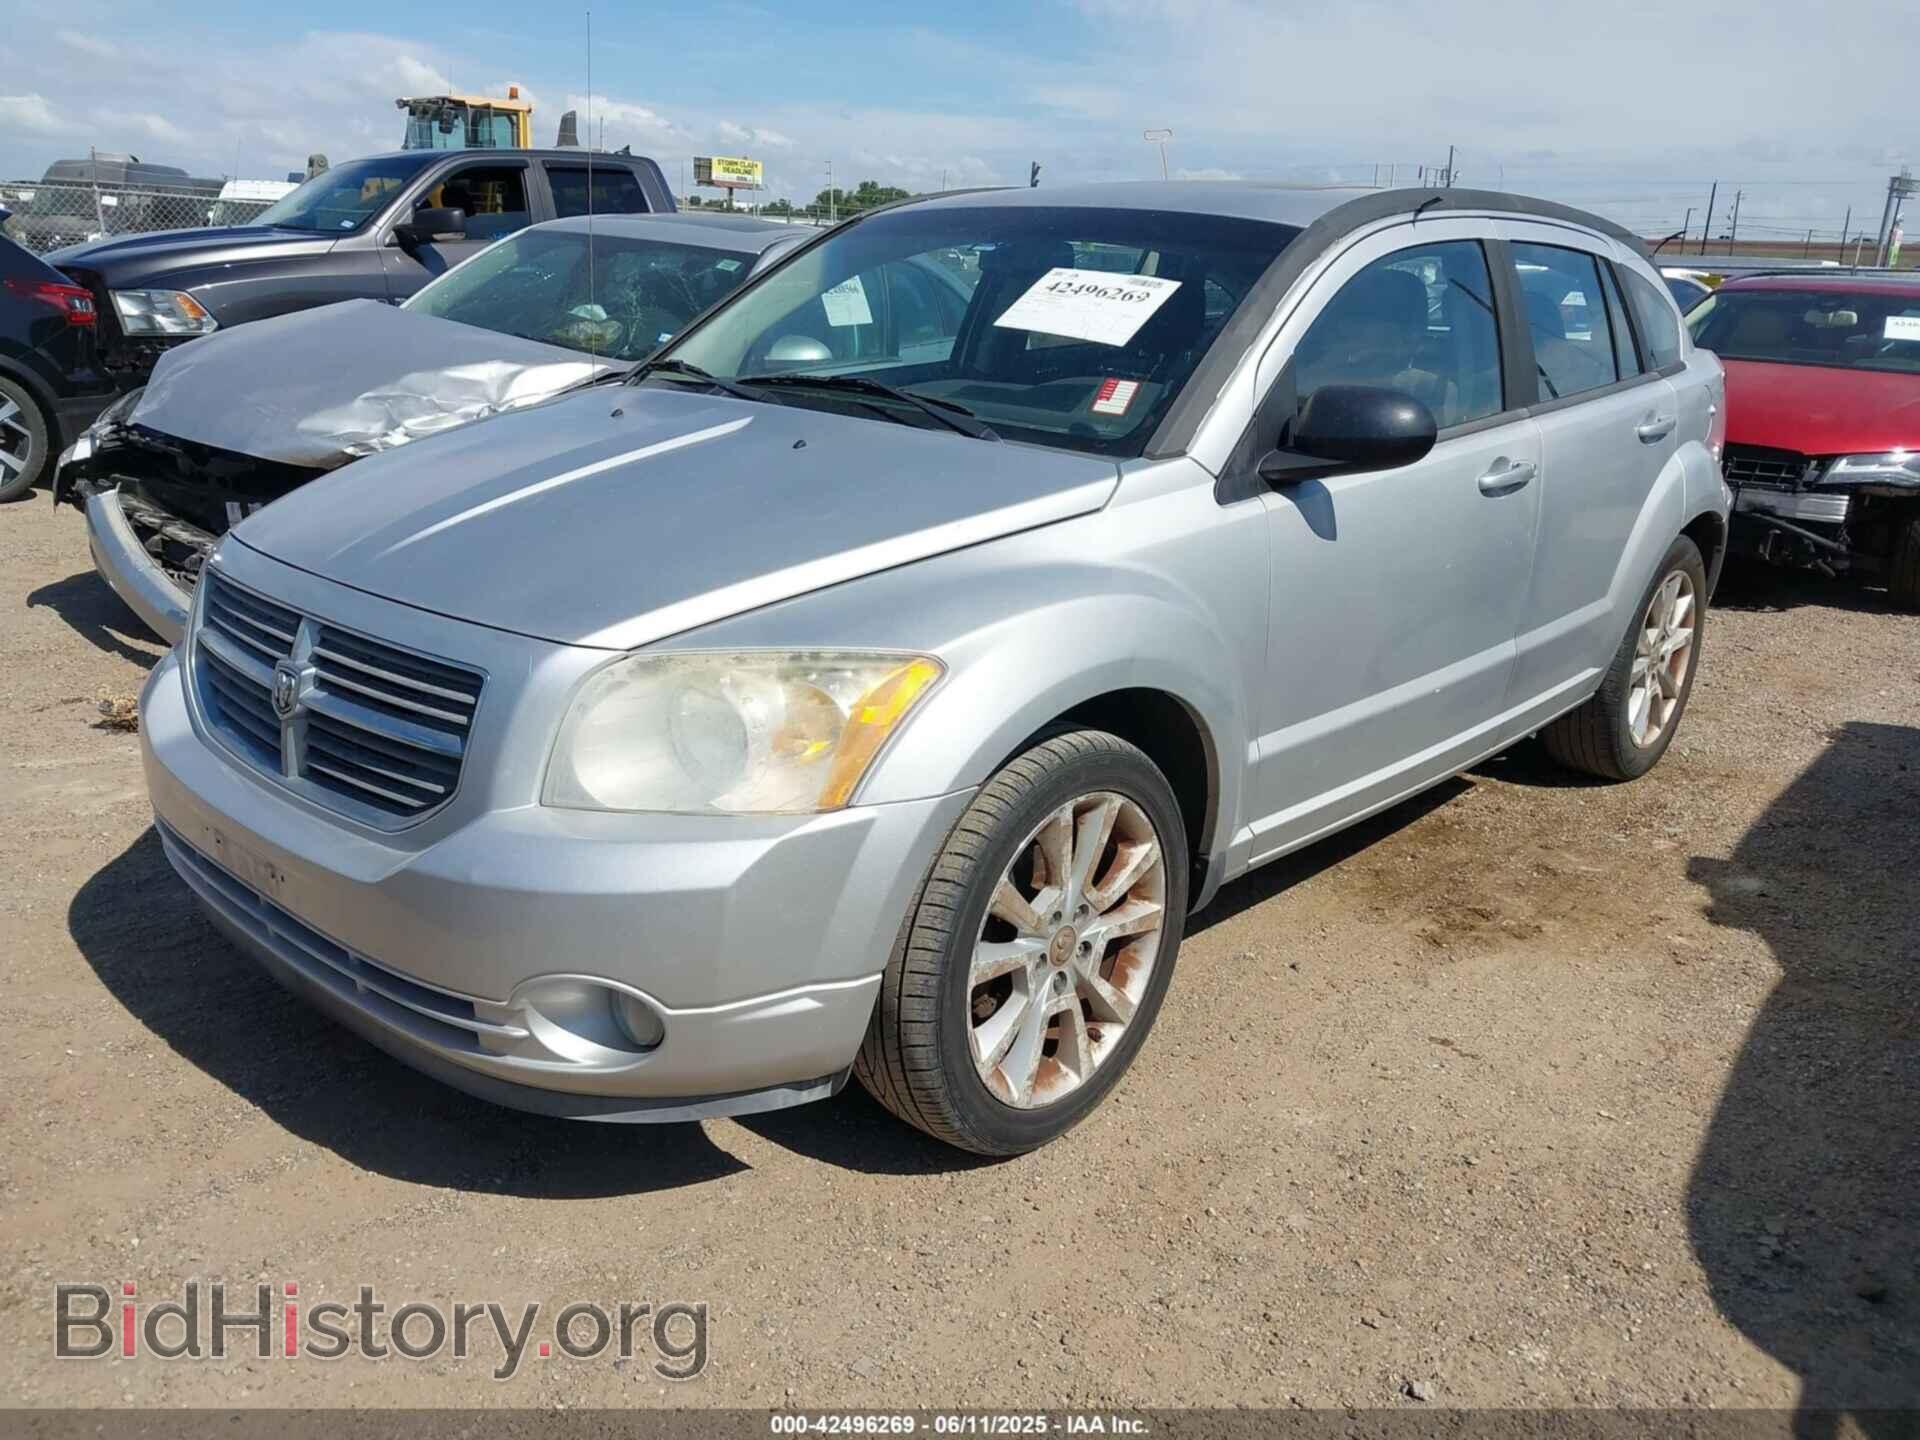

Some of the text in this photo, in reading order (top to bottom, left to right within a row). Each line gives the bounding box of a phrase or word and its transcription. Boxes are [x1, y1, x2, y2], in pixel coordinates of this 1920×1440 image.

[717, 159, 738, 167] STORM
[722, 166, 752, 175] DEADLINE
[1046, 281, 1150, 302] 42496269
